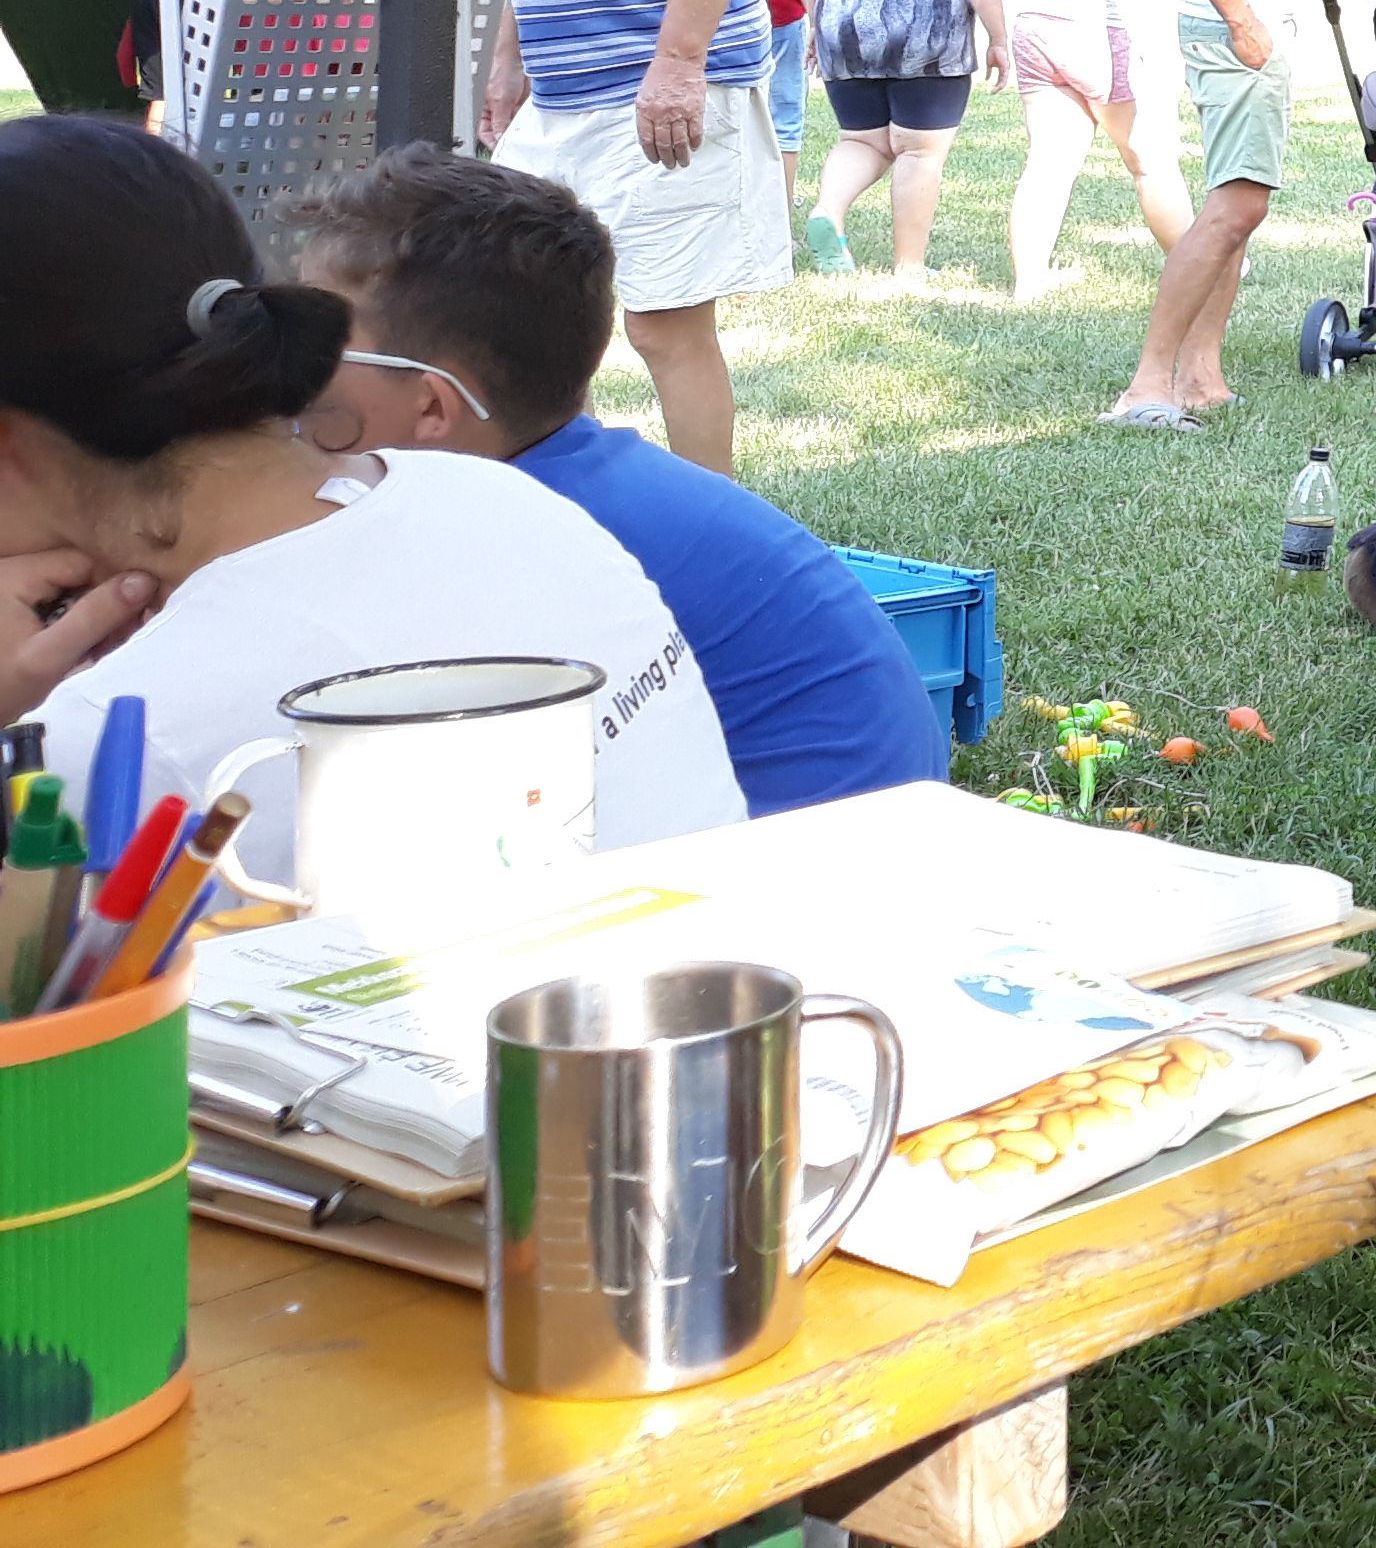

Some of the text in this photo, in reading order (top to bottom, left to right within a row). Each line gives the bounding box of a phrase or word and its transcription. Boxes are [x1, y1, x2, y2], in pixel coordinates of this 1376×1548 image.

[601, 632, 687, 740] a living pla
